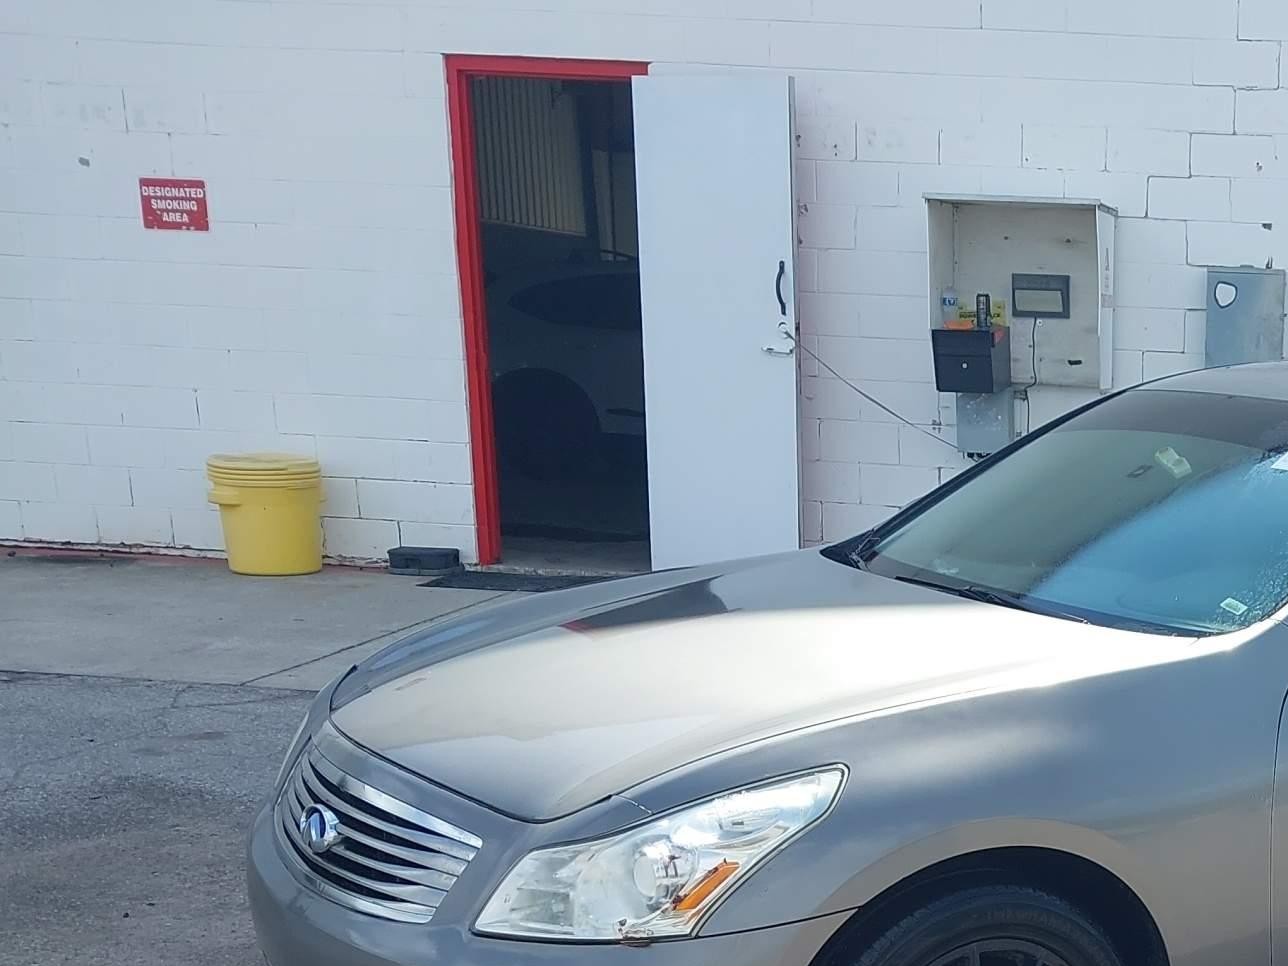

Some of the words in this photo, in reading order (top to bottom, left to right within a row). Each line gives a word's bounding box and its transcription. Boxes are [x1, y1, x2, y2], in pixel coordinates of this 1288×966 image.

[142, 186, 204, 198] DESIGNATED
[151, 199, 198, 211] SMOKING
[162, 212, 189, 223] AREA
